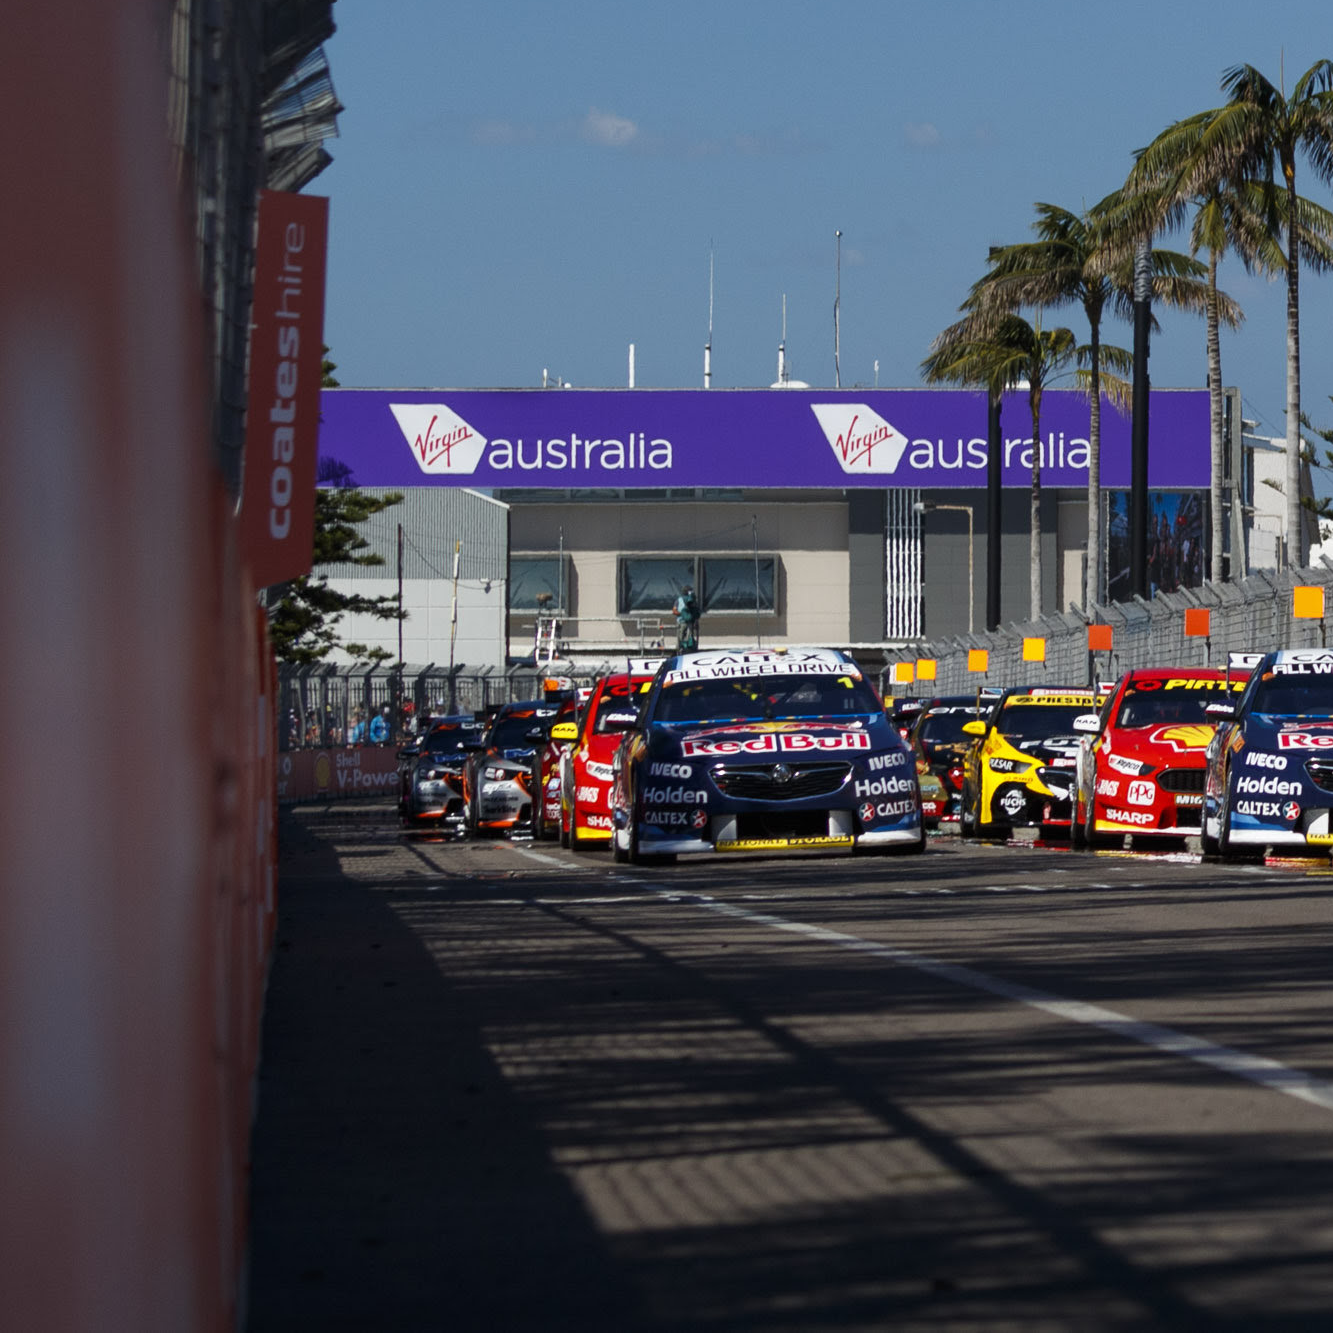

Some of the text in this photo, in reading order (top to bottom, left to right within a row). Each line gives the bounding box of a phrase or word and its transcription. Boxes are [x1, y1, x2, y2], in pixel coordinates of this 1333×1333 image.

[415, 414, 673, 470] Virgin australia
[836, 414, 1092, 470] Virgin ausralia
[670, 663, 852, 682] ALL WHEEL DRIVE
[1272, 663, 1308, 676] ALL
[1164, 678, 1247, 692] PIRTE
[681, 732, 872, 758] Red Bull
[651, 762, 693, 779] IVECO
[868, 752, 906, 772] IVECO
[1245, 751, 1288, 771] IVECO
[336, 768, 400, 789] V-Powe
[854, 775, 917, 798] Holden
[1236, 776, 1303, 796] Holden
[643, 785, 709, 805] Holden
[1000, 795, 1027, 808] FUCHS
[1106, 808, 1155, 825] SHARP
[1236, 799, 1281, 817] CALTEX
[644, 811, 689, 826] CALTEX
